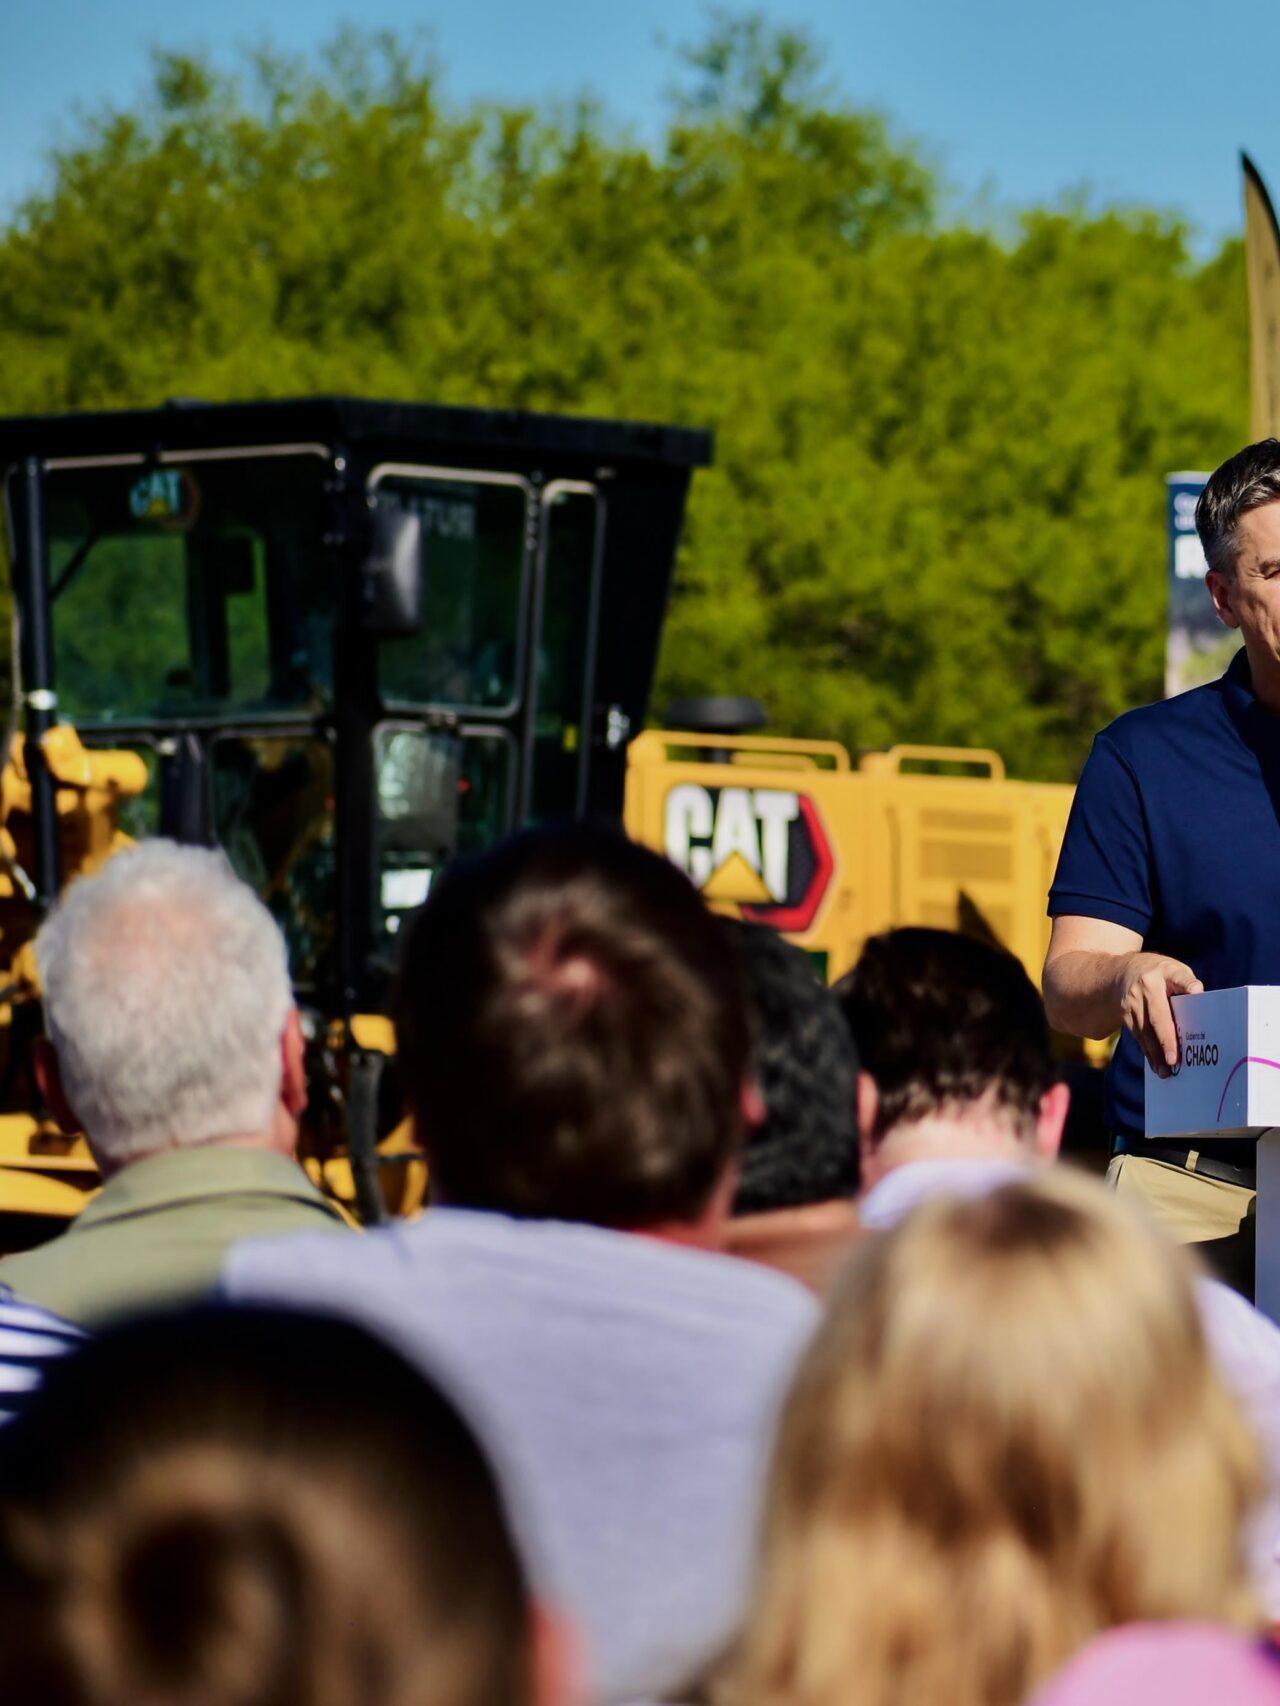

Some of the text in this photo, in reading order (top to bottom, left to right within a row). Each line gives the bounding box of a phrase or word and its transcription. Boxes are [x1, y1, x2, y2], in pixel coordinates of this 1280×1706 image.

[129, 468, 181, 518] CAT
[664, 783, 799, 903] CAT
[1186, 1044, 1219, 1067] CHACO
